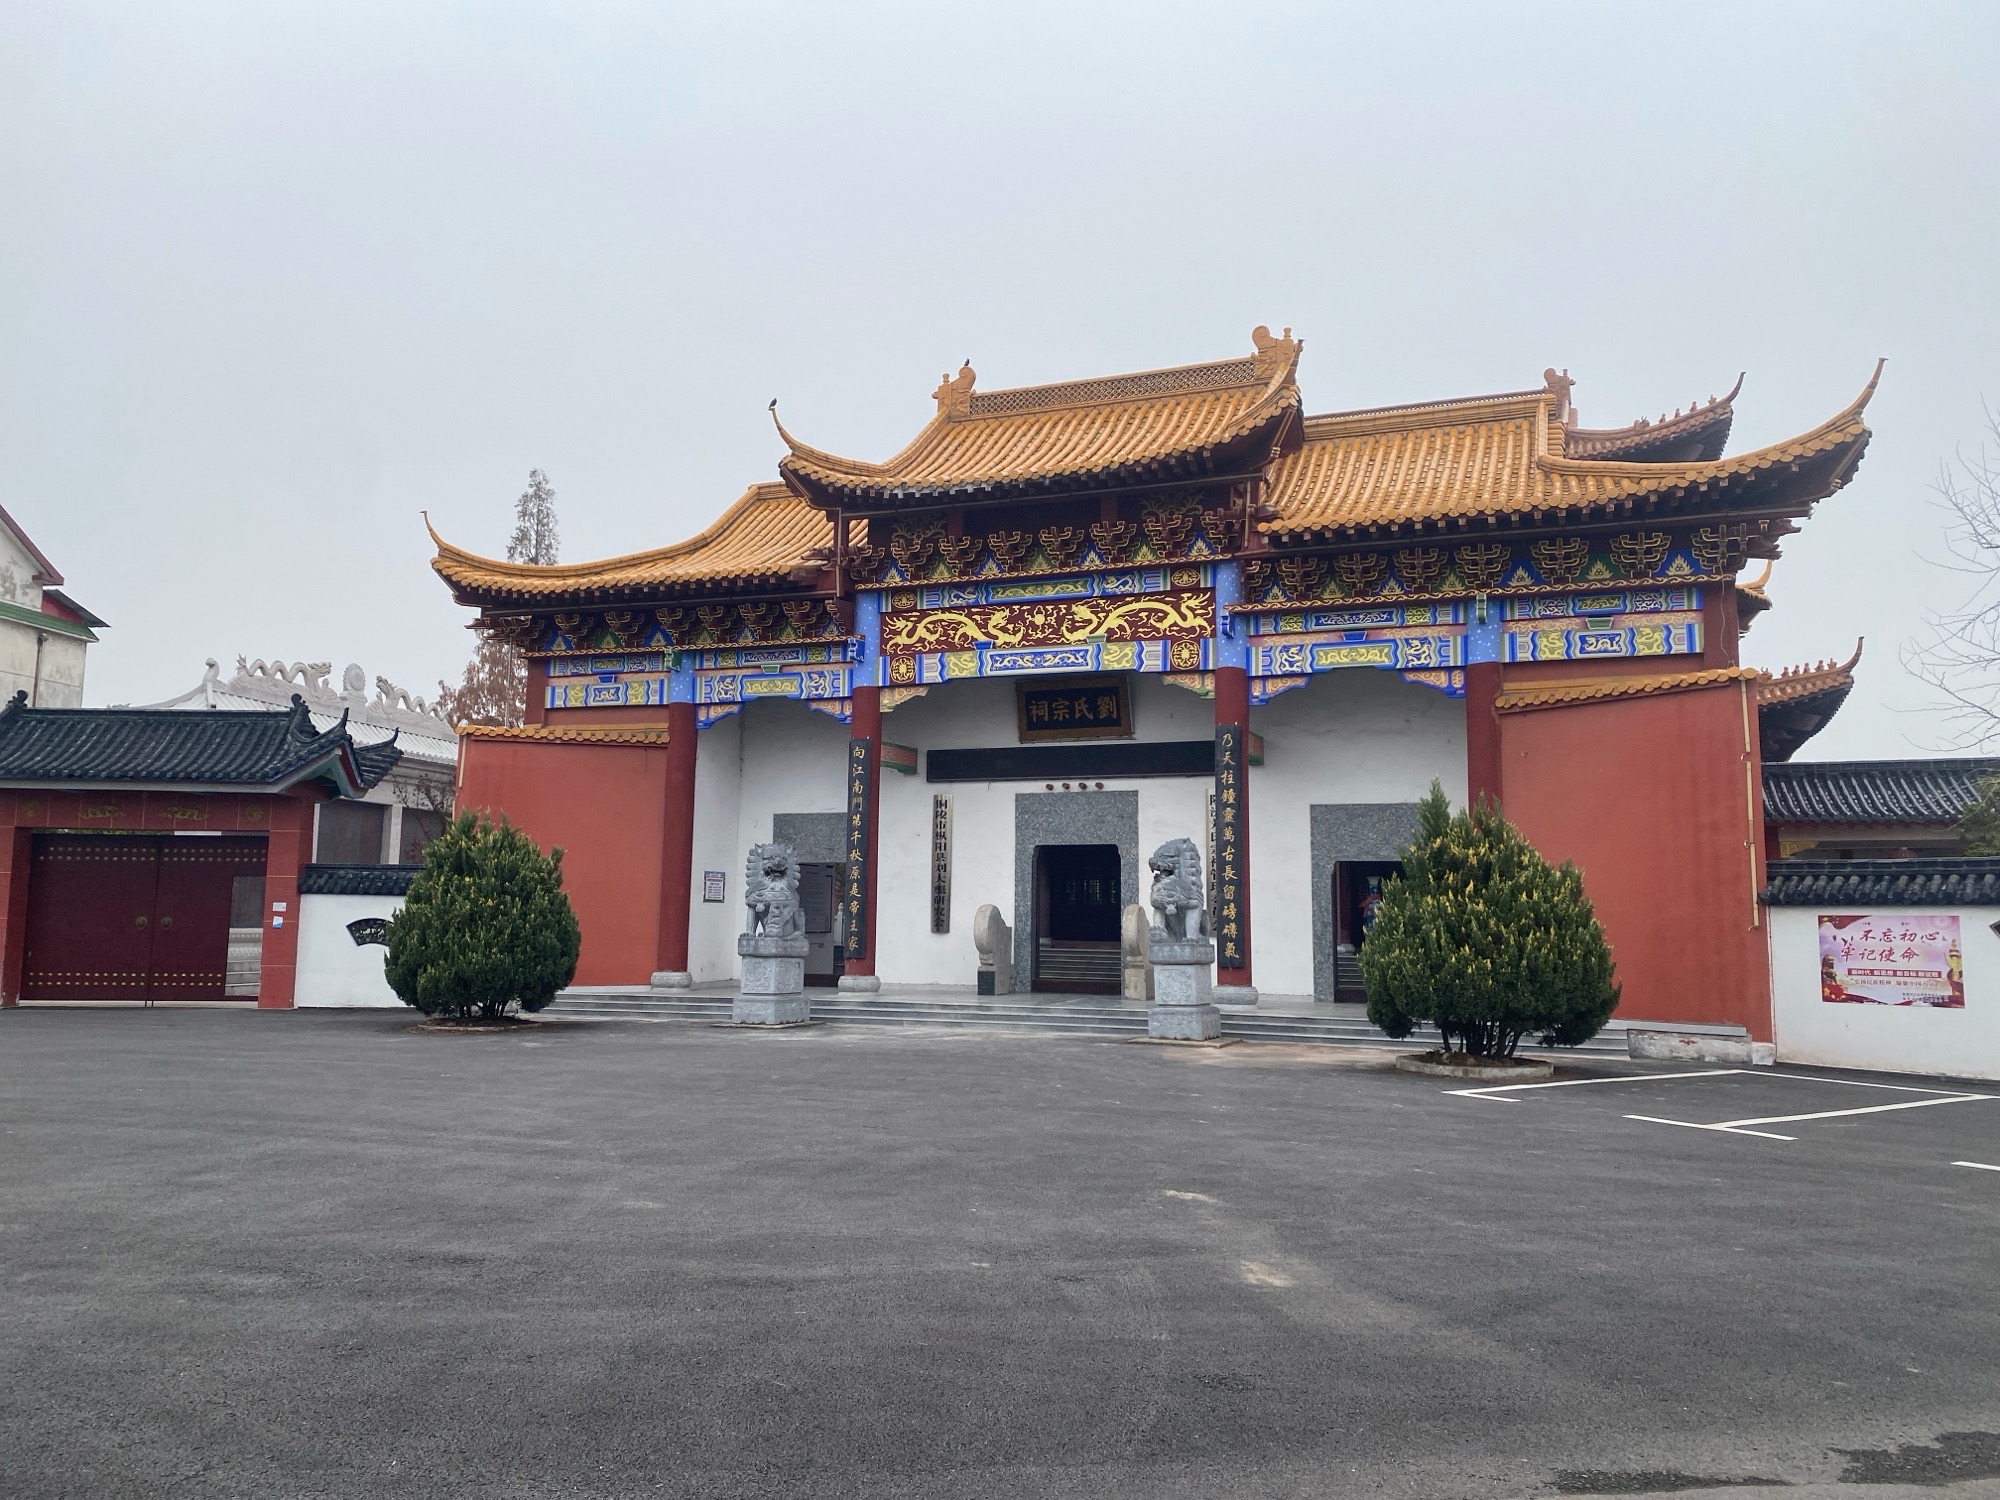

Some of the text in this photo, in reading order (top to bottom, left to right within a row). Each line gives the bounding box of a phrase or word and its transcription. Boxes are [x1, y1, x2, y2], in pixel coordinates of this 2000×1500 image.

[1029, 695, 1118, 722] 劉氏宗祠
[1860, 927, 1940, 943] 不忘初心
[1841, 946, 1920, 963] 牢记使命
